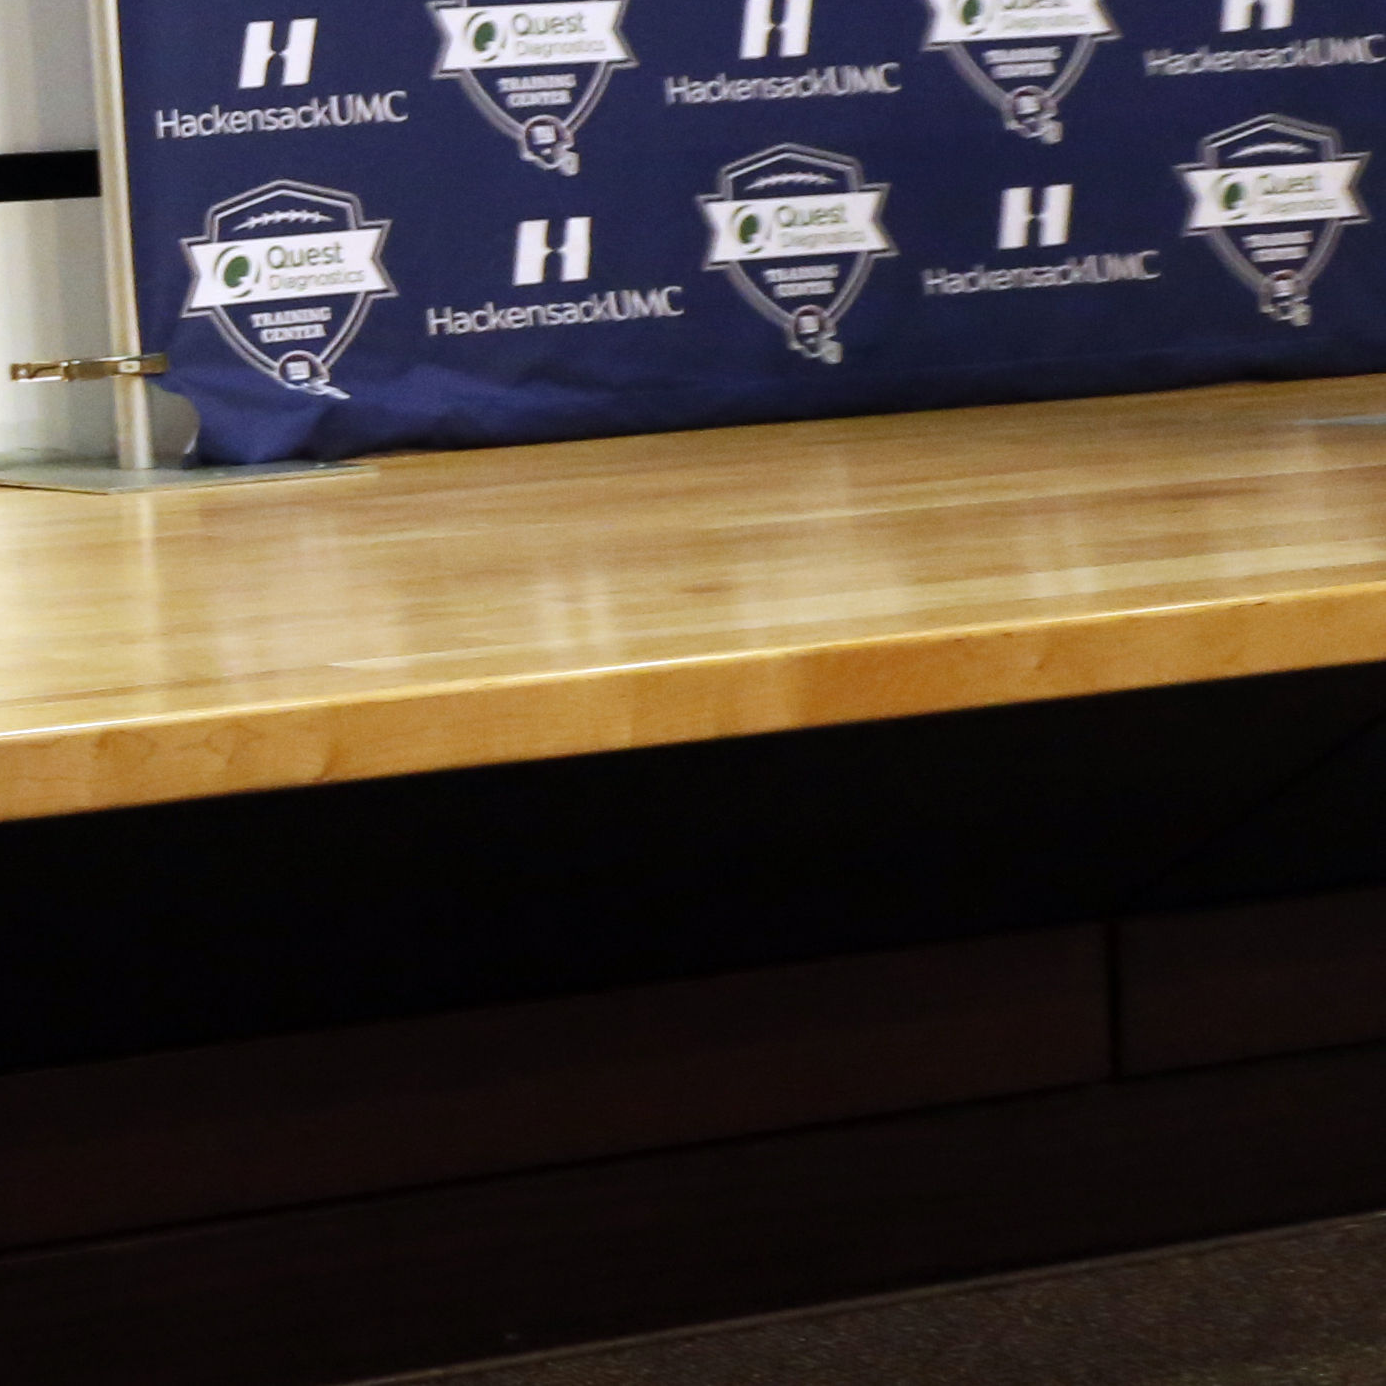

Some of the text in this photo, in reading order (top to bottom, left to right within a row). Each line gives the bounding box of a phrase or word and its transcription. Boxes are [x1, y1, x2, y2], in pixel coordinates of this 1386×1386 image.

[512, 9, 586, 36] Quest
[155, 90, 408, 139] HackensackUMC
[776, 201, 847, 228] Quest
[266, 239, 344, 270] Quest
[269, 266, 365, 292] Diagnostics
[249, 305, 333, 329] TRAINING
[426, 286, 684, 336] HackensackUMC
